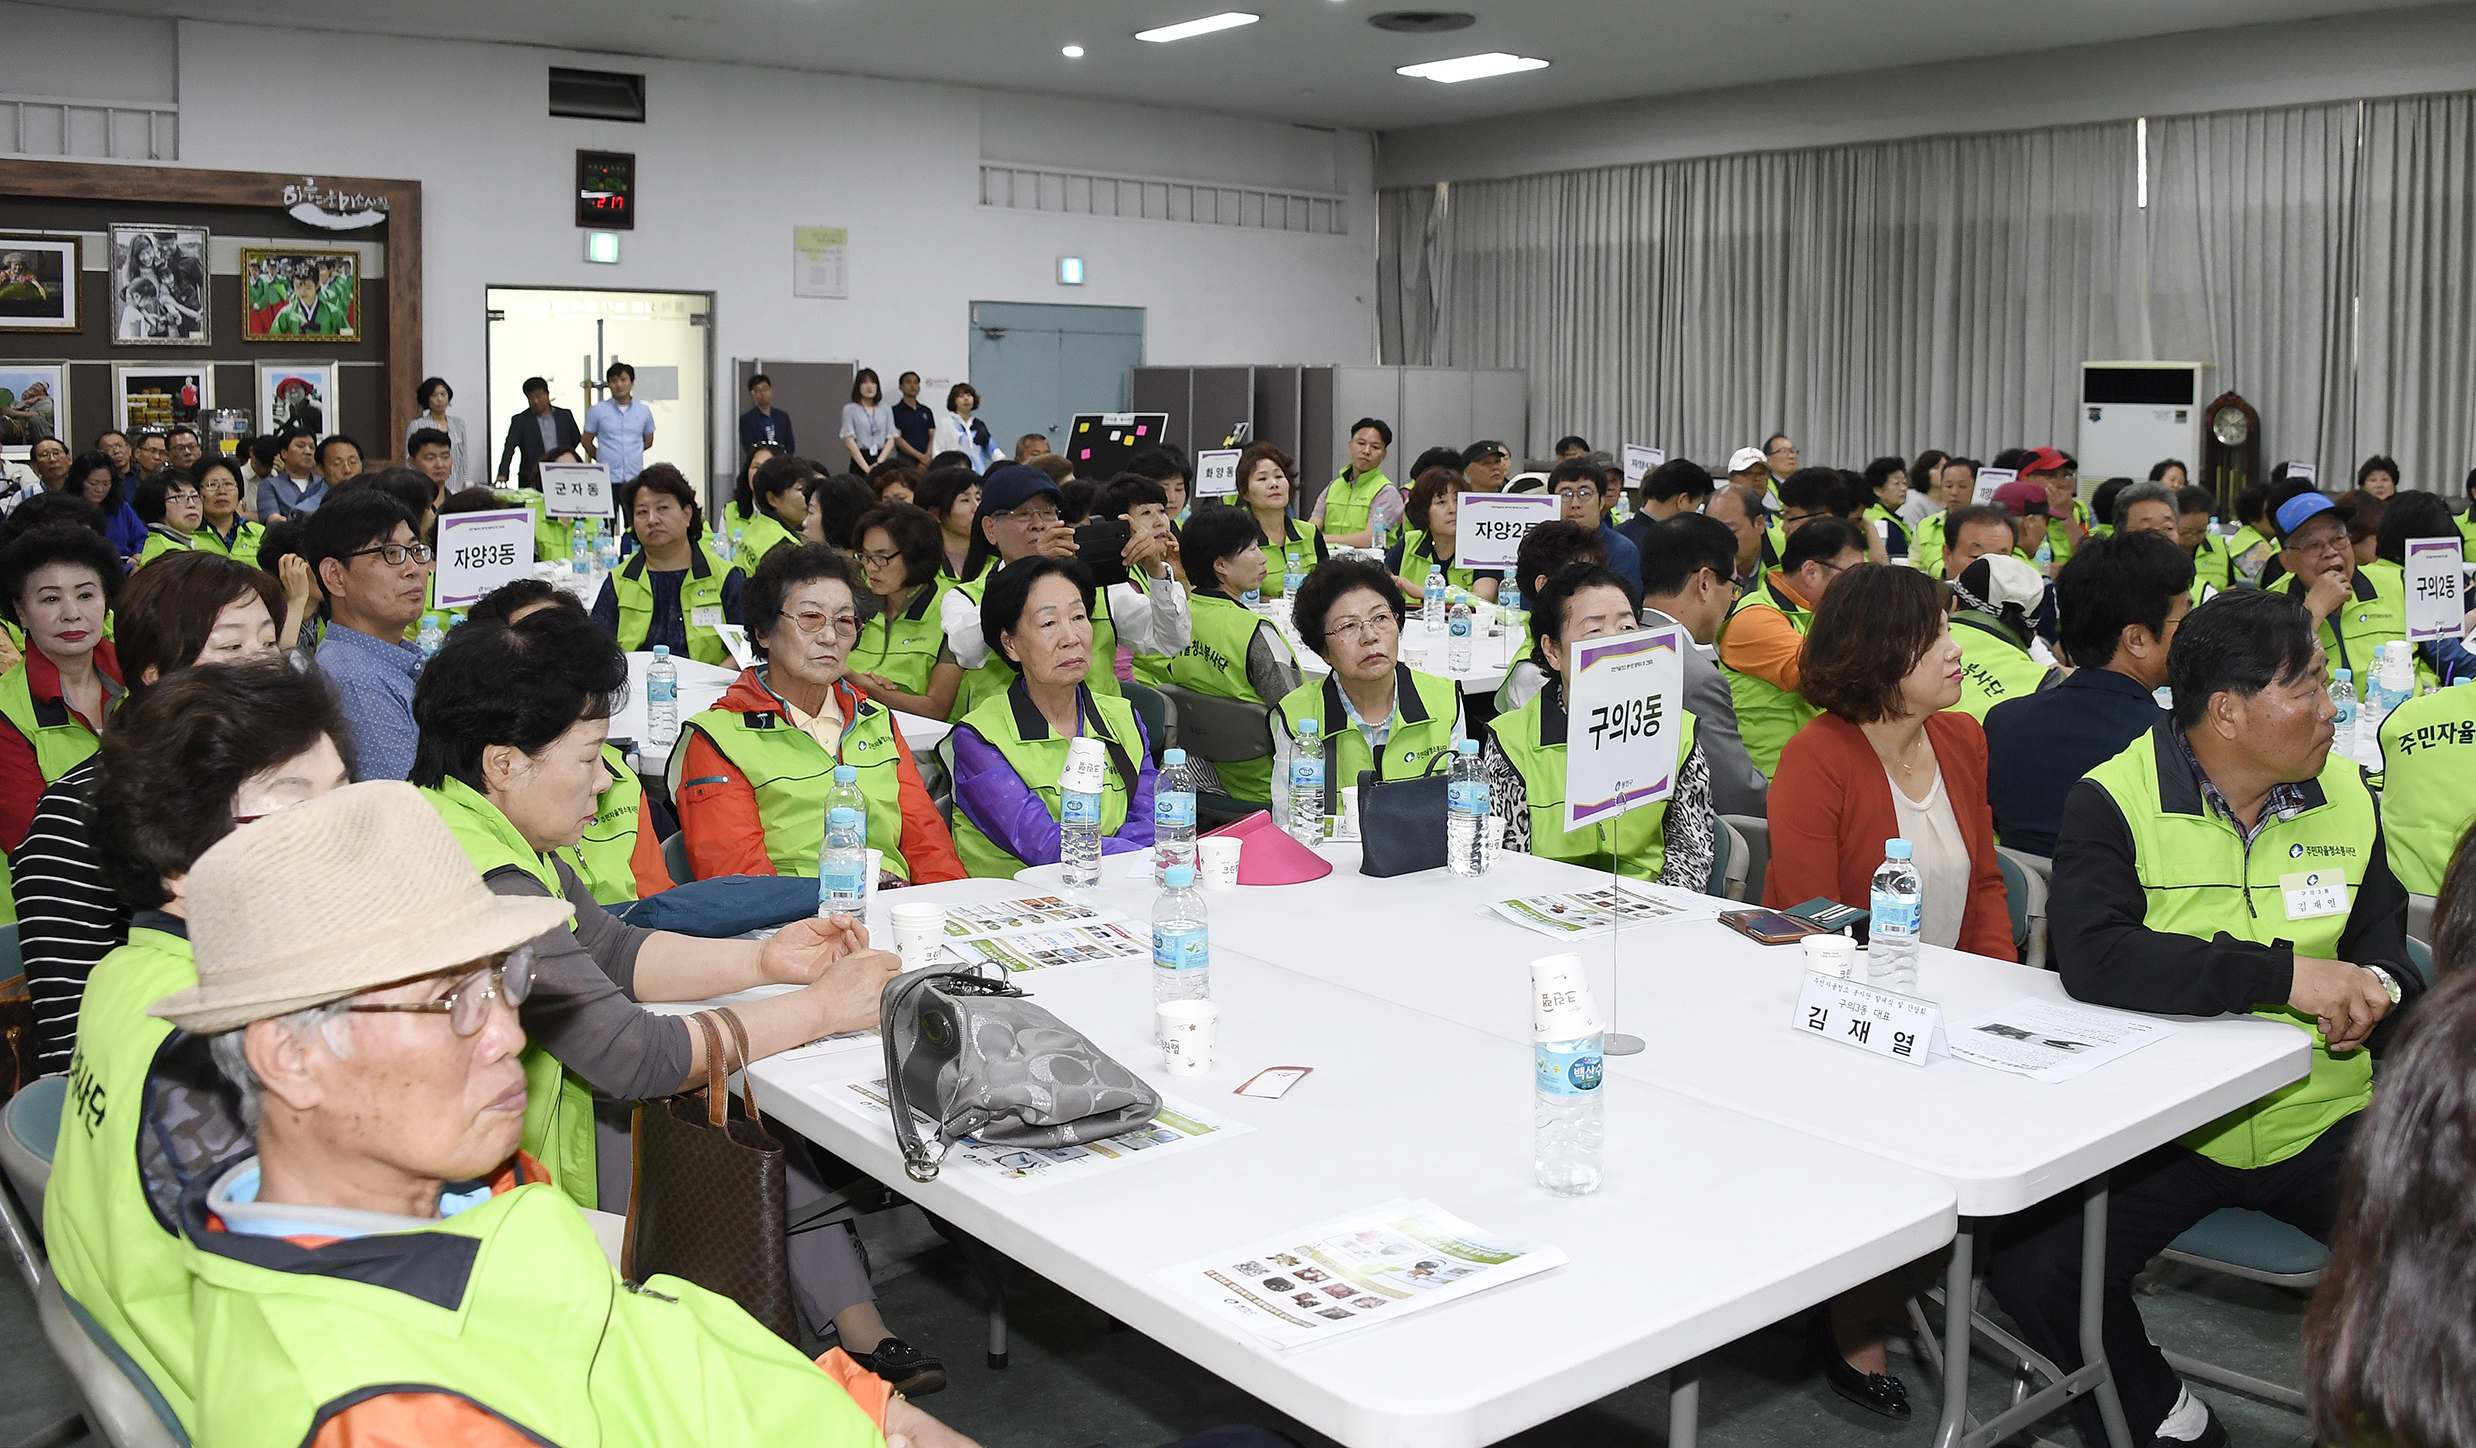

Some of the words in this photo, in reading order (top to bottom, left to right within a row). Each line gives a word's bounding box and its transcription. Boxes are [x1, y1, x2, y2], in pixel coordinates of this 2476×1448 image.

[454, 543, 516, 570] 자양3동
[2416, 575, 2455, 601] 구의2동
[1588, 694, 1663, 751] 구의3동
[2398, 720, 2476, 756] 주민자율
[1838, 998, 1869, 1016] 구의3동
[1872, 1008, 1891, 1021] 대표
[1573, 1063, 1603, 1081] 백산수
